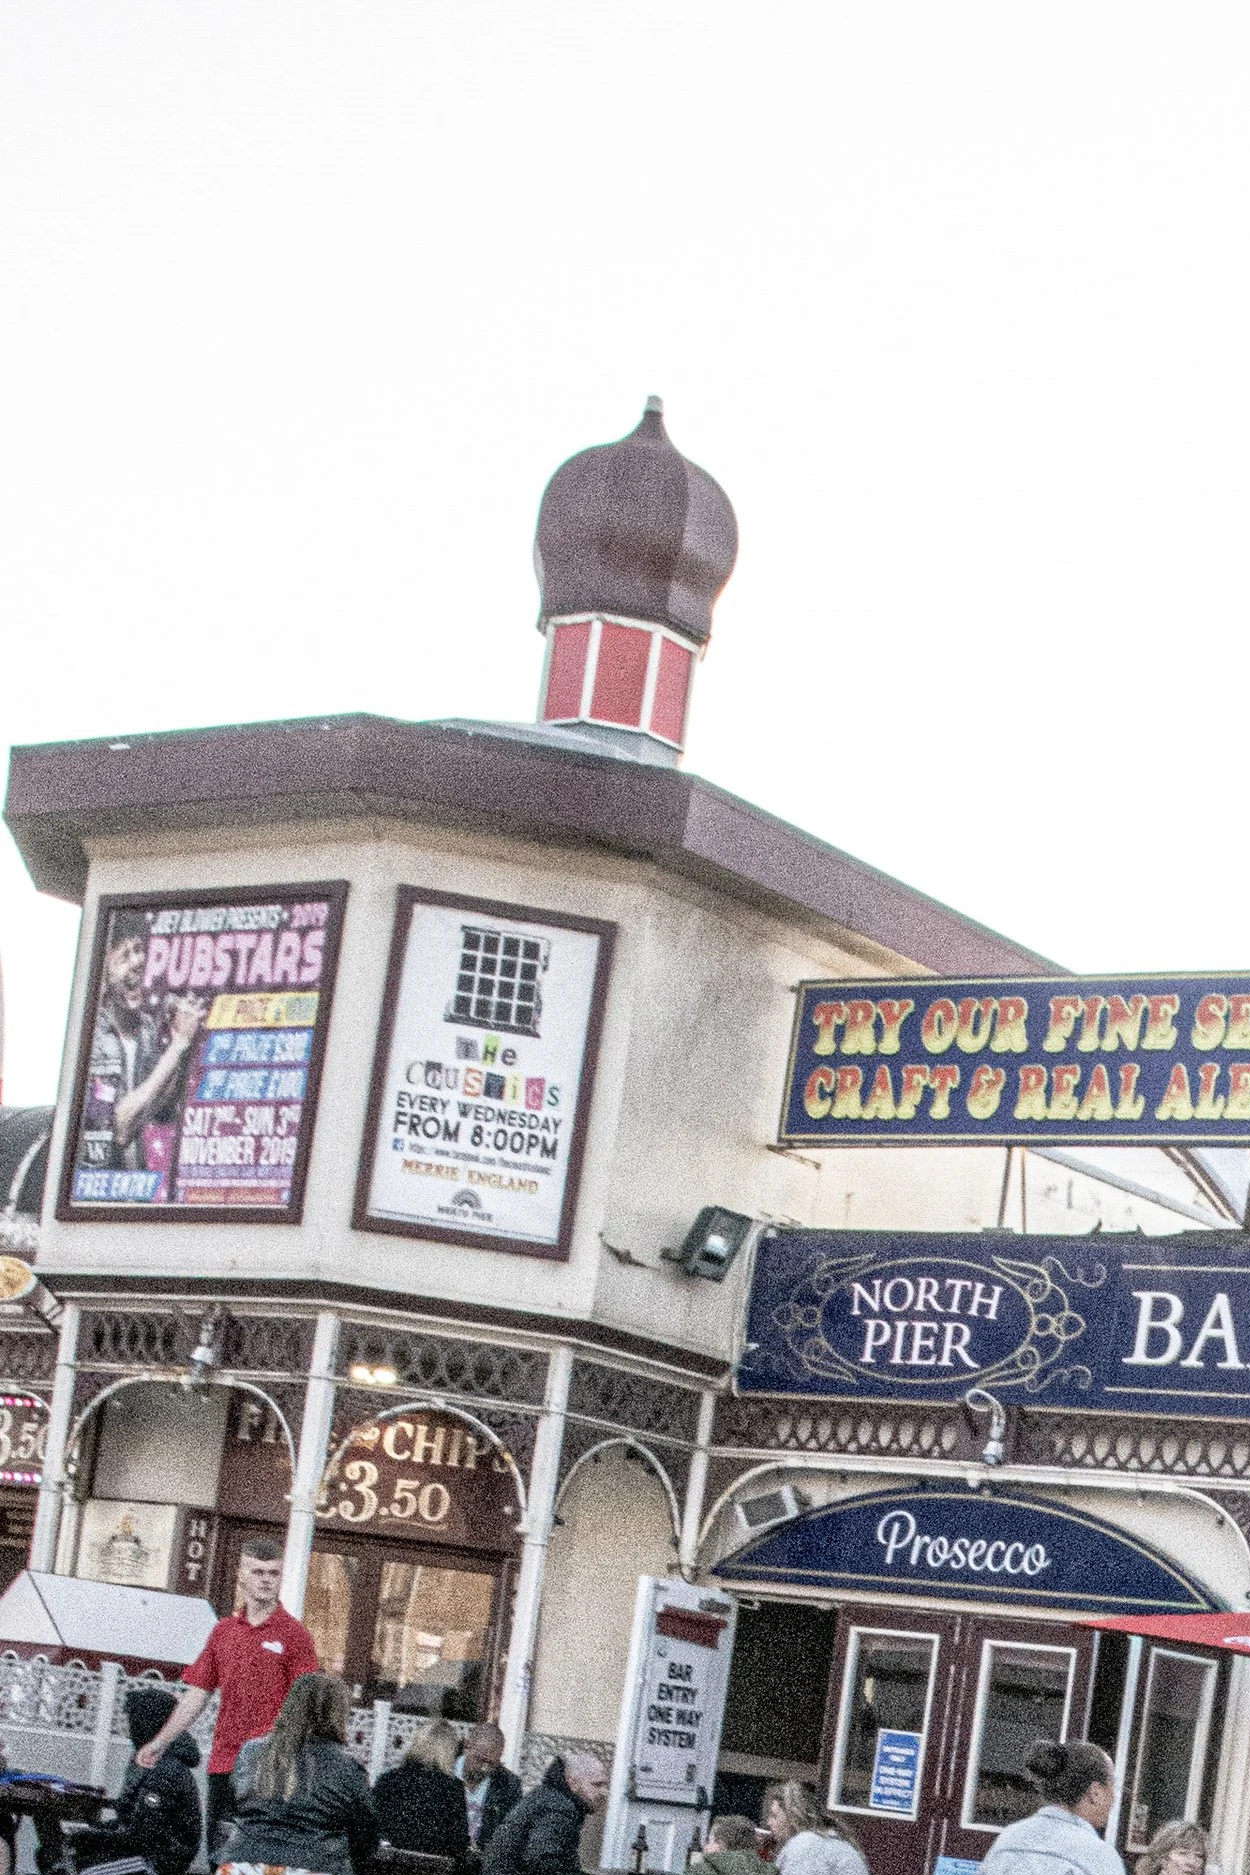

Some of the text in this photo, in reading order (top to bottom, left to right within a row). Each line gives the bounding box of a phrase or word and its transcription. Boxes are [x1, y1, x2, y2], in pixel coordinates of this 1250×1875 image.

[143, 929, 327, 988] PUBSTARS
[813, 998, 914, 1055] TRY
[921, 997, 1029, 1054] OUR
[1042, 993, 1180, 1053] FINE
[397, 1091, 562, 1134] EVERY WEDNESDAY
[804, 1064, 960, 1120] CRAFT
[966, 1063, 1005, 1120] &
[1013, 1062, 1146, 1121] REAL
[183, 1106, 214, 1137] SAT
[393, 1112, 461, 1143] FROM
[470, 1125, 558, 1159] 8:00PM
[180, 1136, 298, 1166] NOVEMBER 2019
[74, 1172, 111, 1199] FREE
[110, 1172, 158, 1199] ENTRY
[467, 1169, 539, 1195] ENGLAND
[851, 1277, 1003, 1320] NORTH
[859, 1319, 981, 1369] PIER
[186, 1519, 208, 1583] HOT
[877, 1510, 1052, 1576] Prosecco
[668, 1661, 694, 1682] BAR
[658, 1682, 698, 1706] ENTRY
[648, 1704, 703, 1728] ONE WAY
[648, 1727, 697, 1750] SYSTEM
